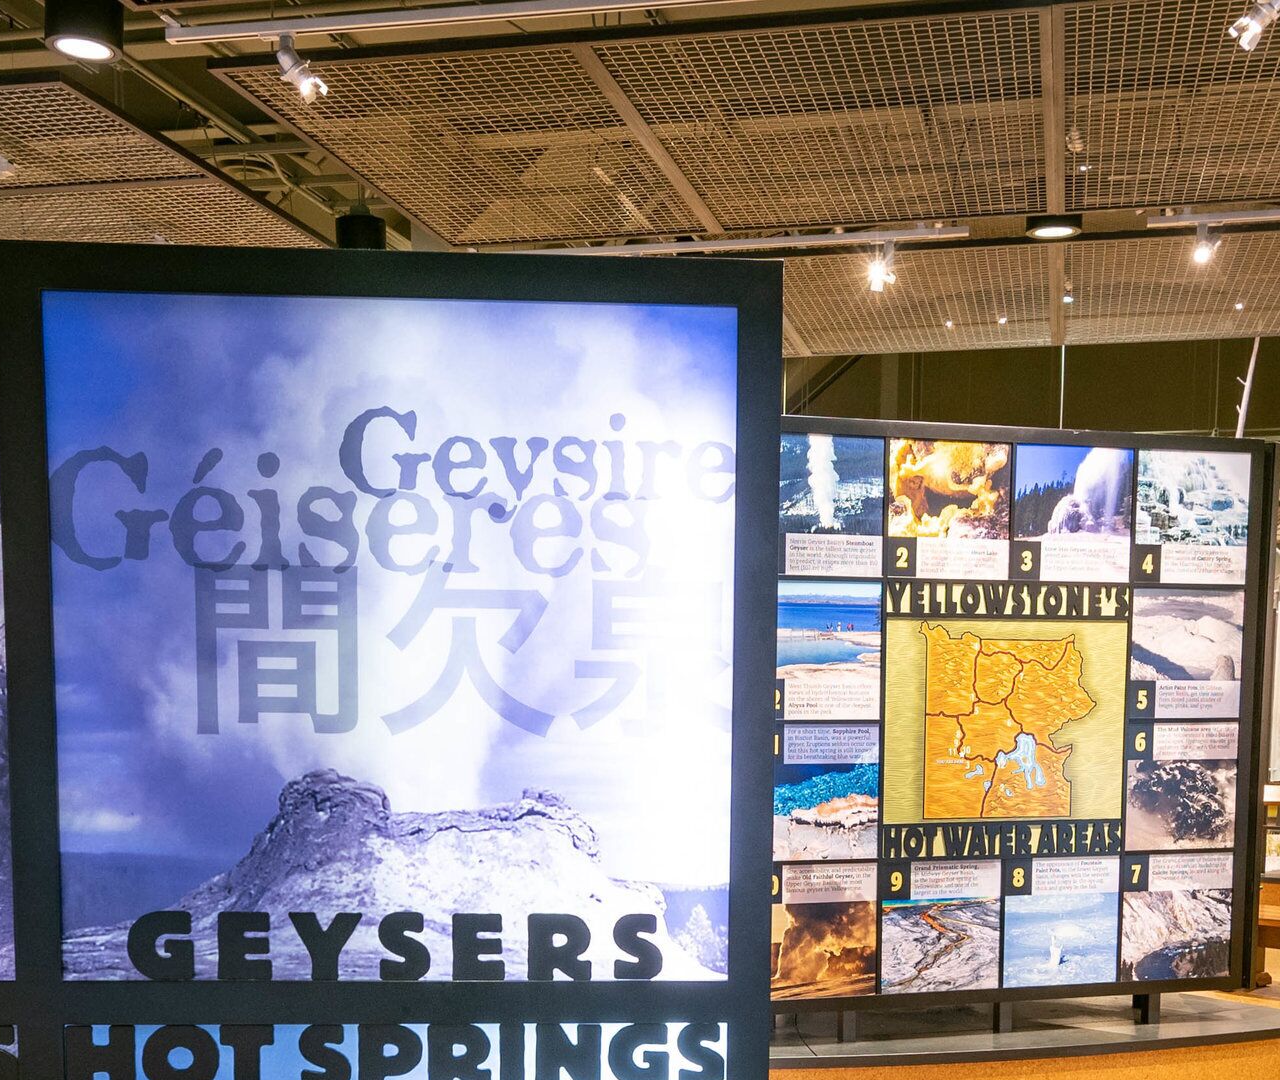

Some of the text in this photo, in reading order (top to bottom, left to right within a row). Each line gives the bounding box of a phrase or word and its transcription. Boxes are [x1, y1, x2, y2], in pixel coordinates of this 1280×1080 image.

[48, 446, 650, 578] Géiseres
[896, 547, 908, 568] 2
[1021, 551, 1032, 571] 3
[1142, 554, 1153, 573] 4
[888, 581, 1129, 616] YELLOWSTONE'S
[1136, 690, 1147, 710] 5
[1135, 732, 1146, 752] 6
[884, 822, 1120, 858] HOT WATER AREAS
[890, 872, 902, 892] 9
[1013, 868, 1024, 887] 8
[1131, 864, 1141, 883] 7
[127, 910, 664, 982] GEYSERS
